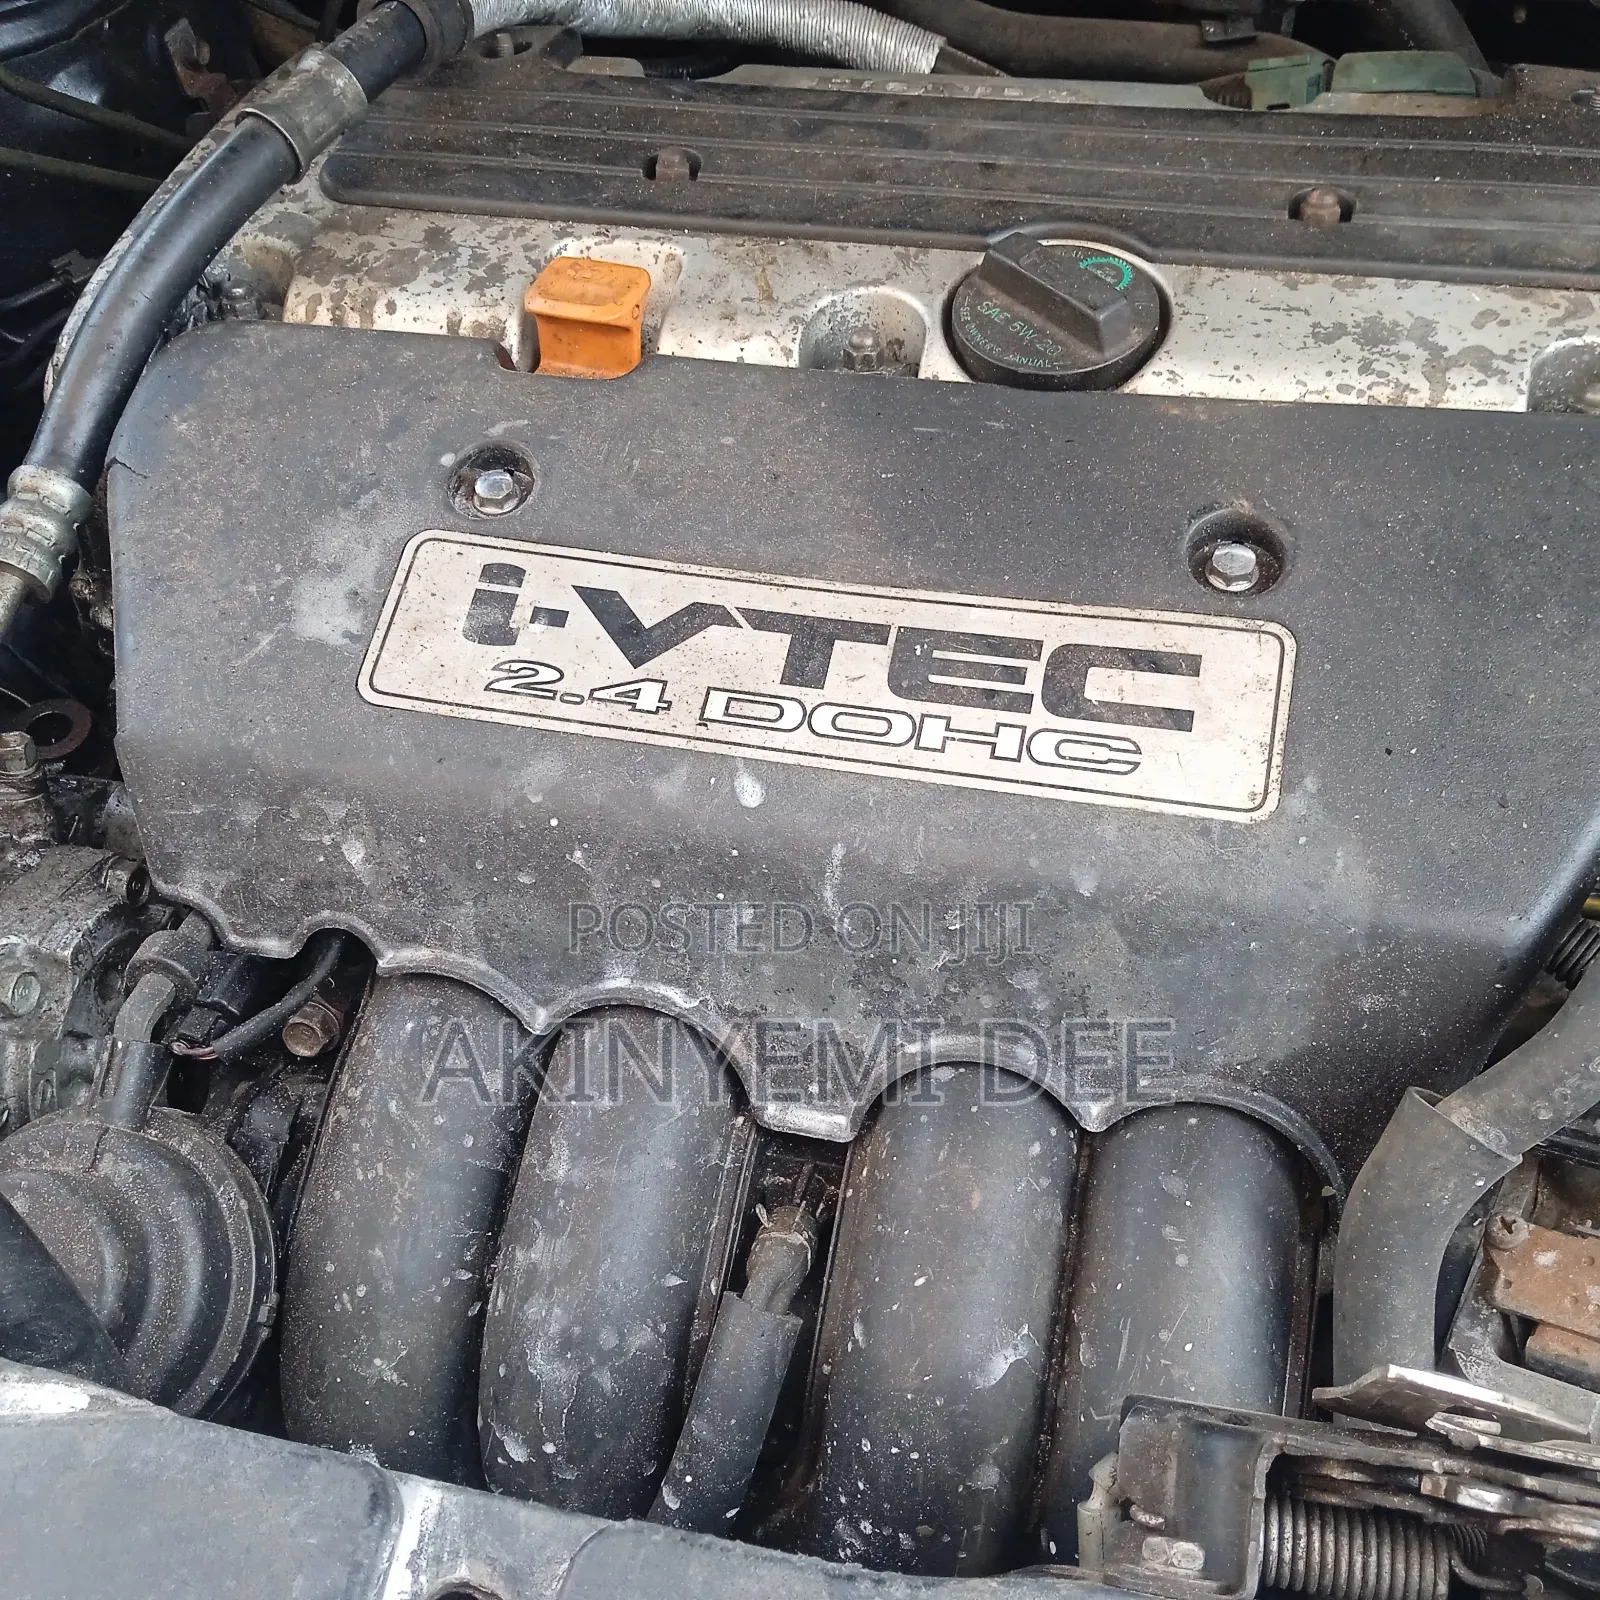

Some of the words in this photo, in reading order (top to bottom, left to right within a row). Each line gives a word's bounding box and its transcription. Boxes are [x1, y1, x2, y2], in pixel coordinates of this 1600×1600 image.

[978, 301, 1011, 323] SAE
[462, 562, 1202, 732] i-VTEC
[484, 659, 672, 715] 2.4
[701, 686, 1142, 776] DOHC
